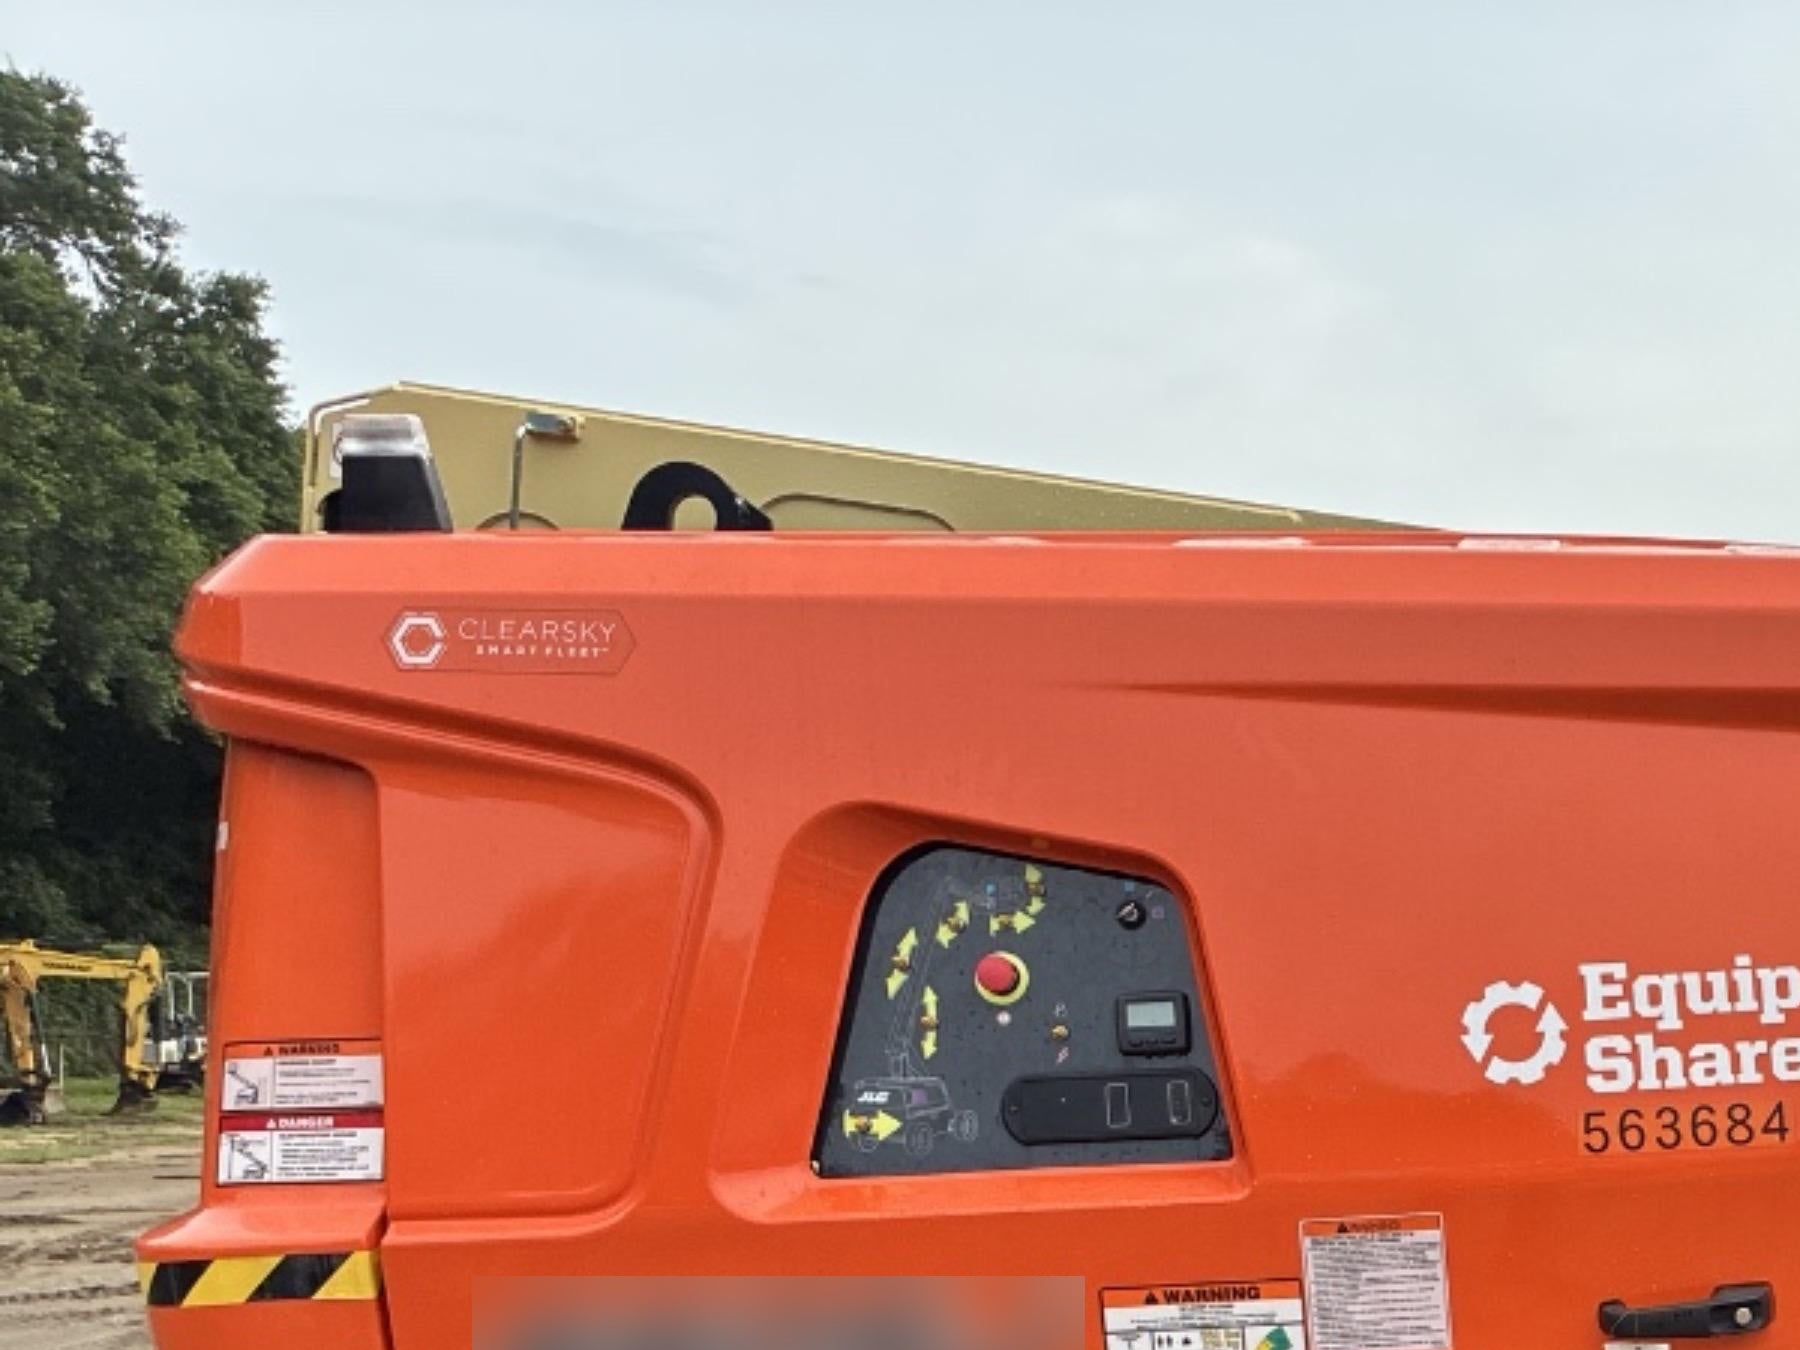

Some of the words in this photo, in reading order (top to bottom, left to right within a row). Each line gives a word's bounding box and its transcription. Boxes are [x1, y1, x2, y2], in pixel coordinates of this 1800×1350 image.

[457, 617, 616, 643] CLEARSKY
[1582, 1100, 1791, 1153] 563684
[1163, 1286, 1261, 1304] WARNING
